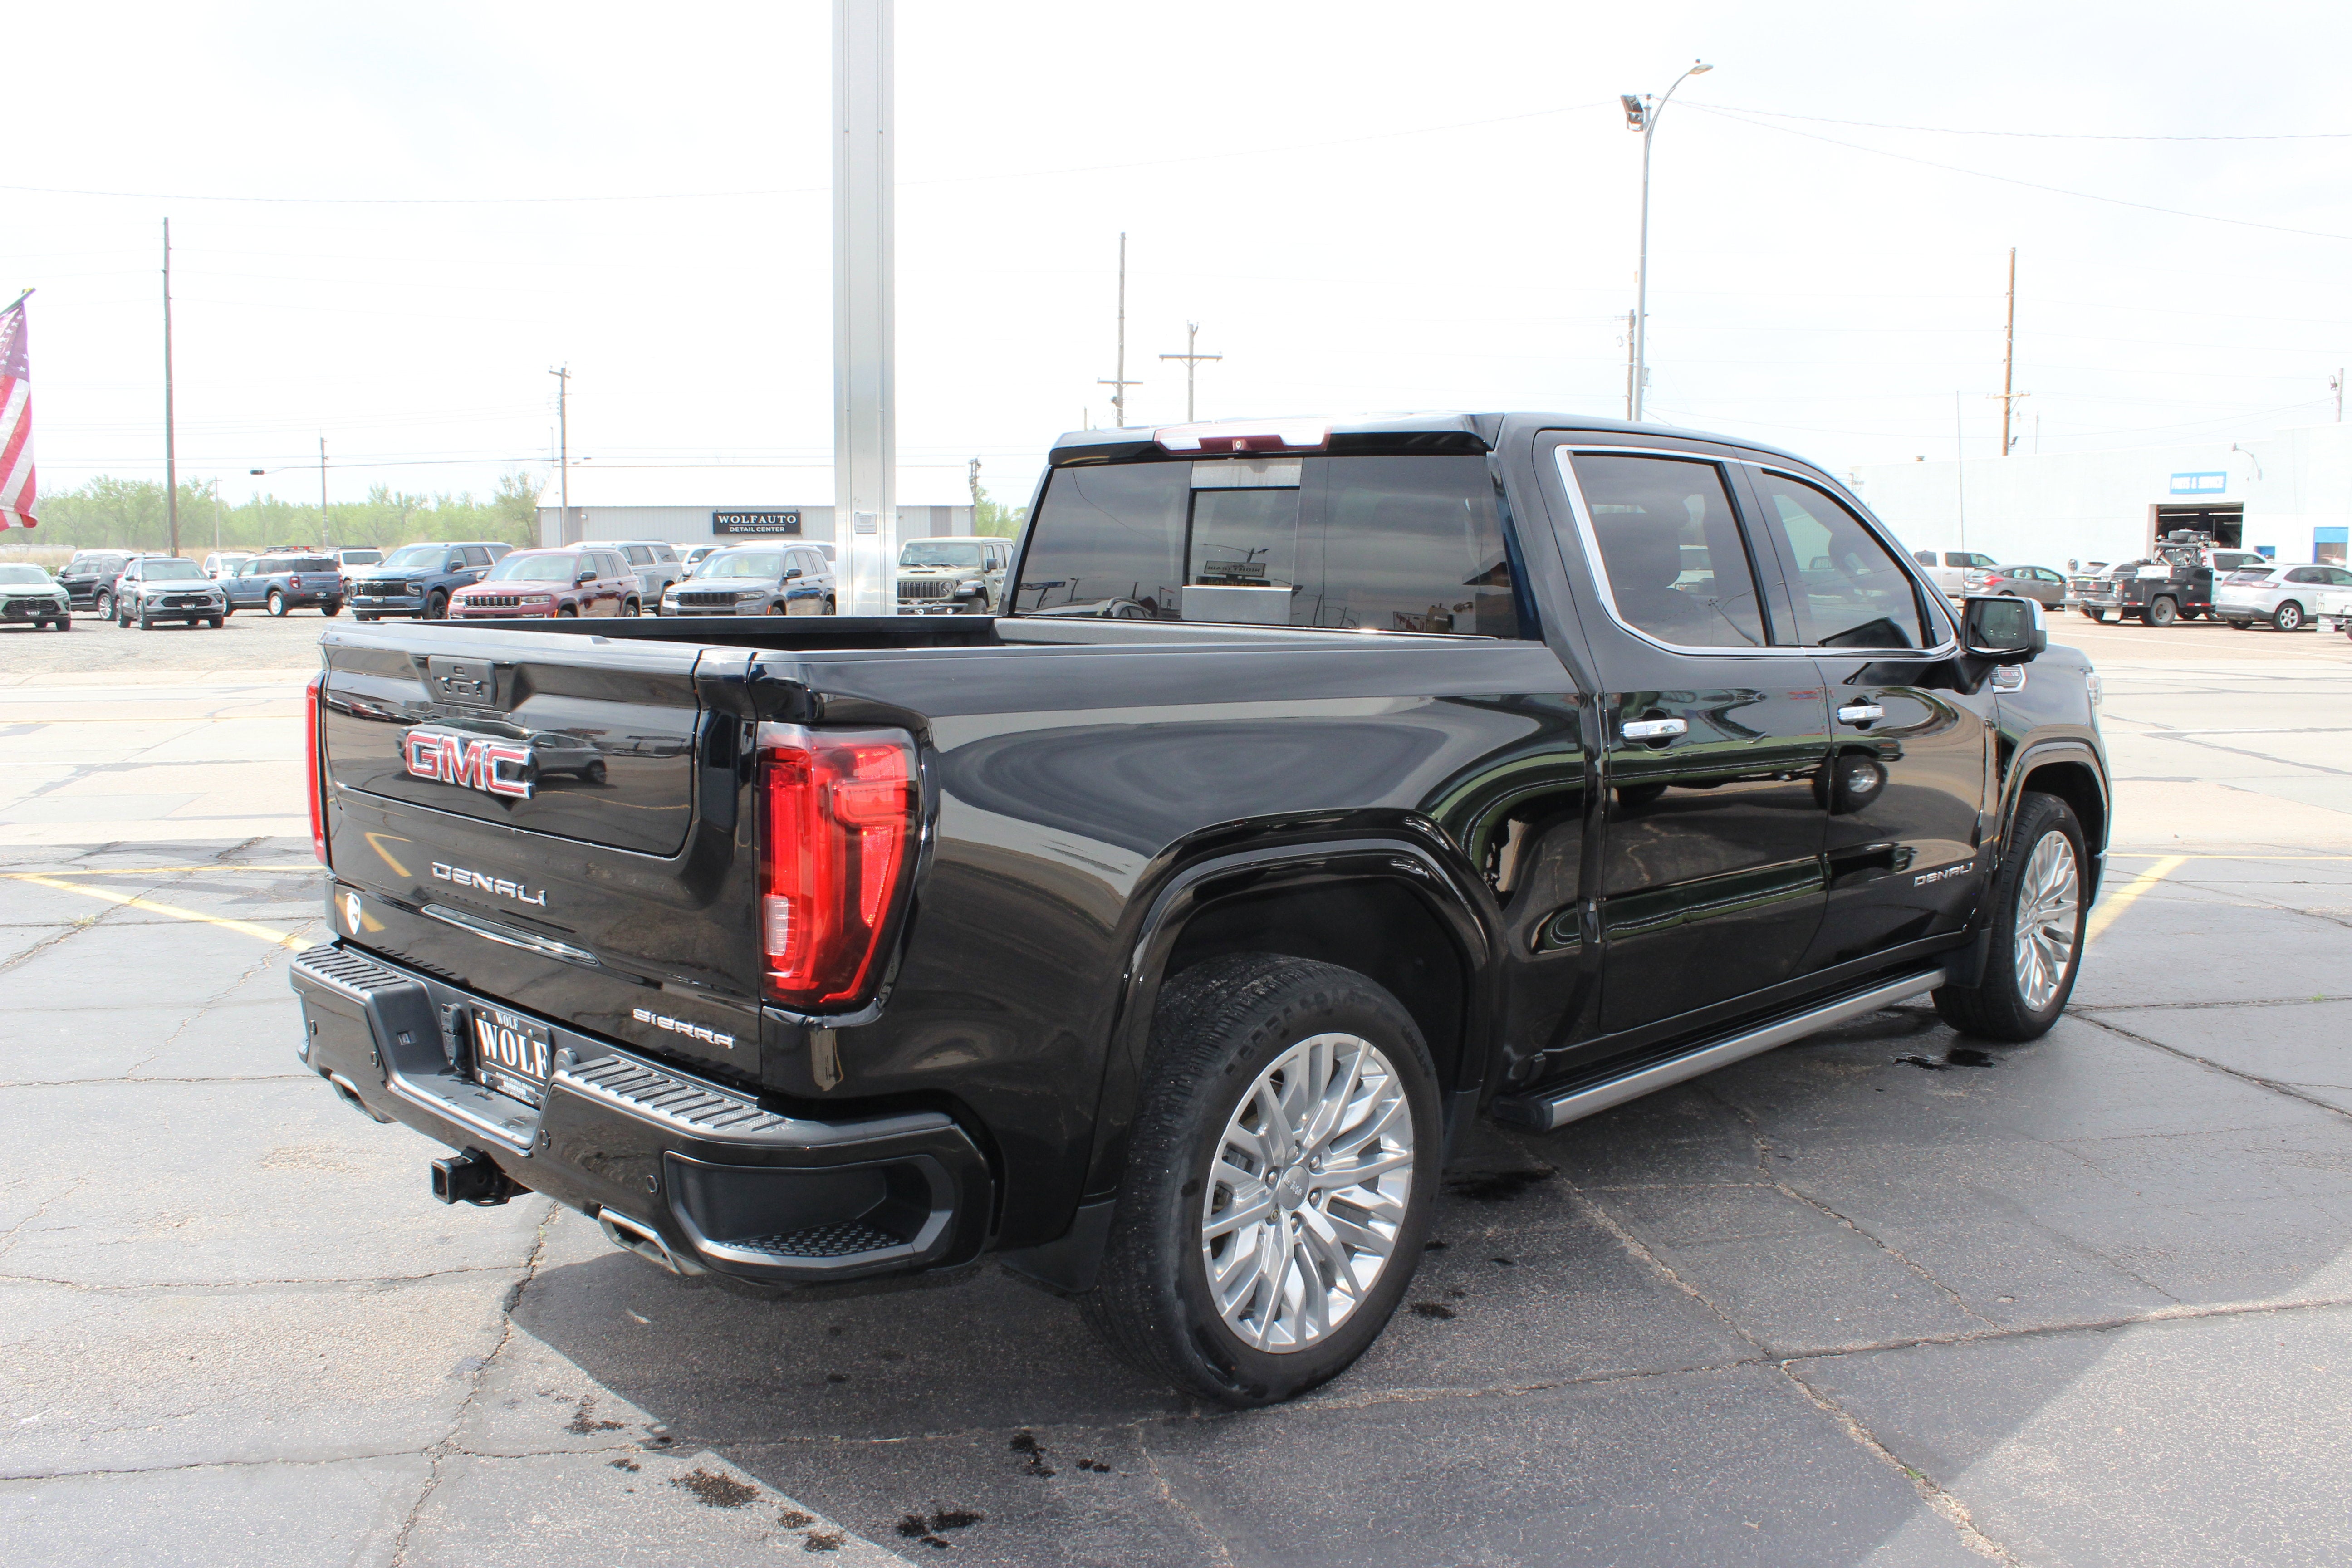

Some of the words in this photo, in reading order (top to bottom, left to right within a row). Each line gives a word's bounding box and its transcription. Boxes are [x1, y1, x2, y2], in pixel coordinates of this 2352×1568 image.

[2171, 477, 2190, 490] PARTS
[2198, 475, 2224, 489] SERVICE
[718, 515, 797, 524] WOLFAUTO
[406, 730, 533, 799] GMC
[432, 862, 547, 906] DENALI
[1913, 862, 1974, 887] DENALI
[495, 1011, 519, 1030] WOLF
[632, 1008, 735, 1049] SIERRA
[476, 1018, 548, 1080] WOLF
